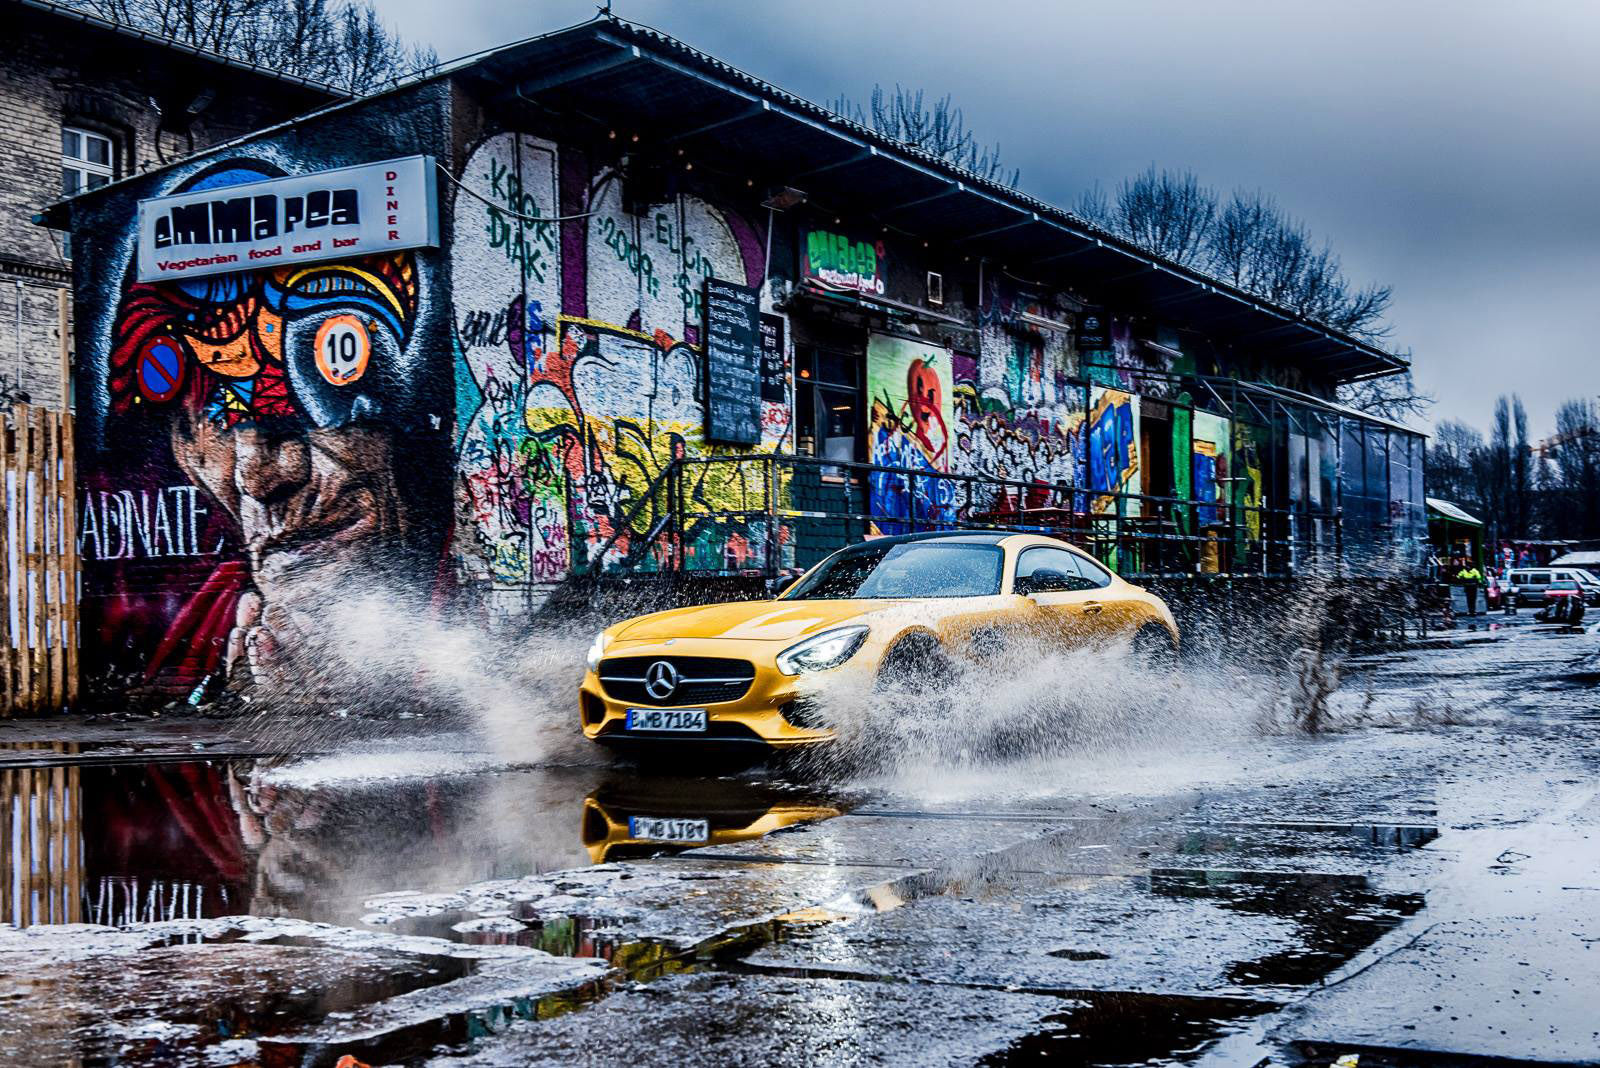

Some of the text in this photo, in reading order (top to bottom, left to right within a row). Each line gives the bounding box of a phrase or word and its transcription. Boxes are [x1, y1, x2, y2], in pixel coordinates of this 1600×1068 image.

[385, 171, 400, 241] DINER
[157, 236, 360, 271] Vegetarian food and bar
[328, 331, 356, 363] 10
[80, 485, 224, 560] ADNATE
